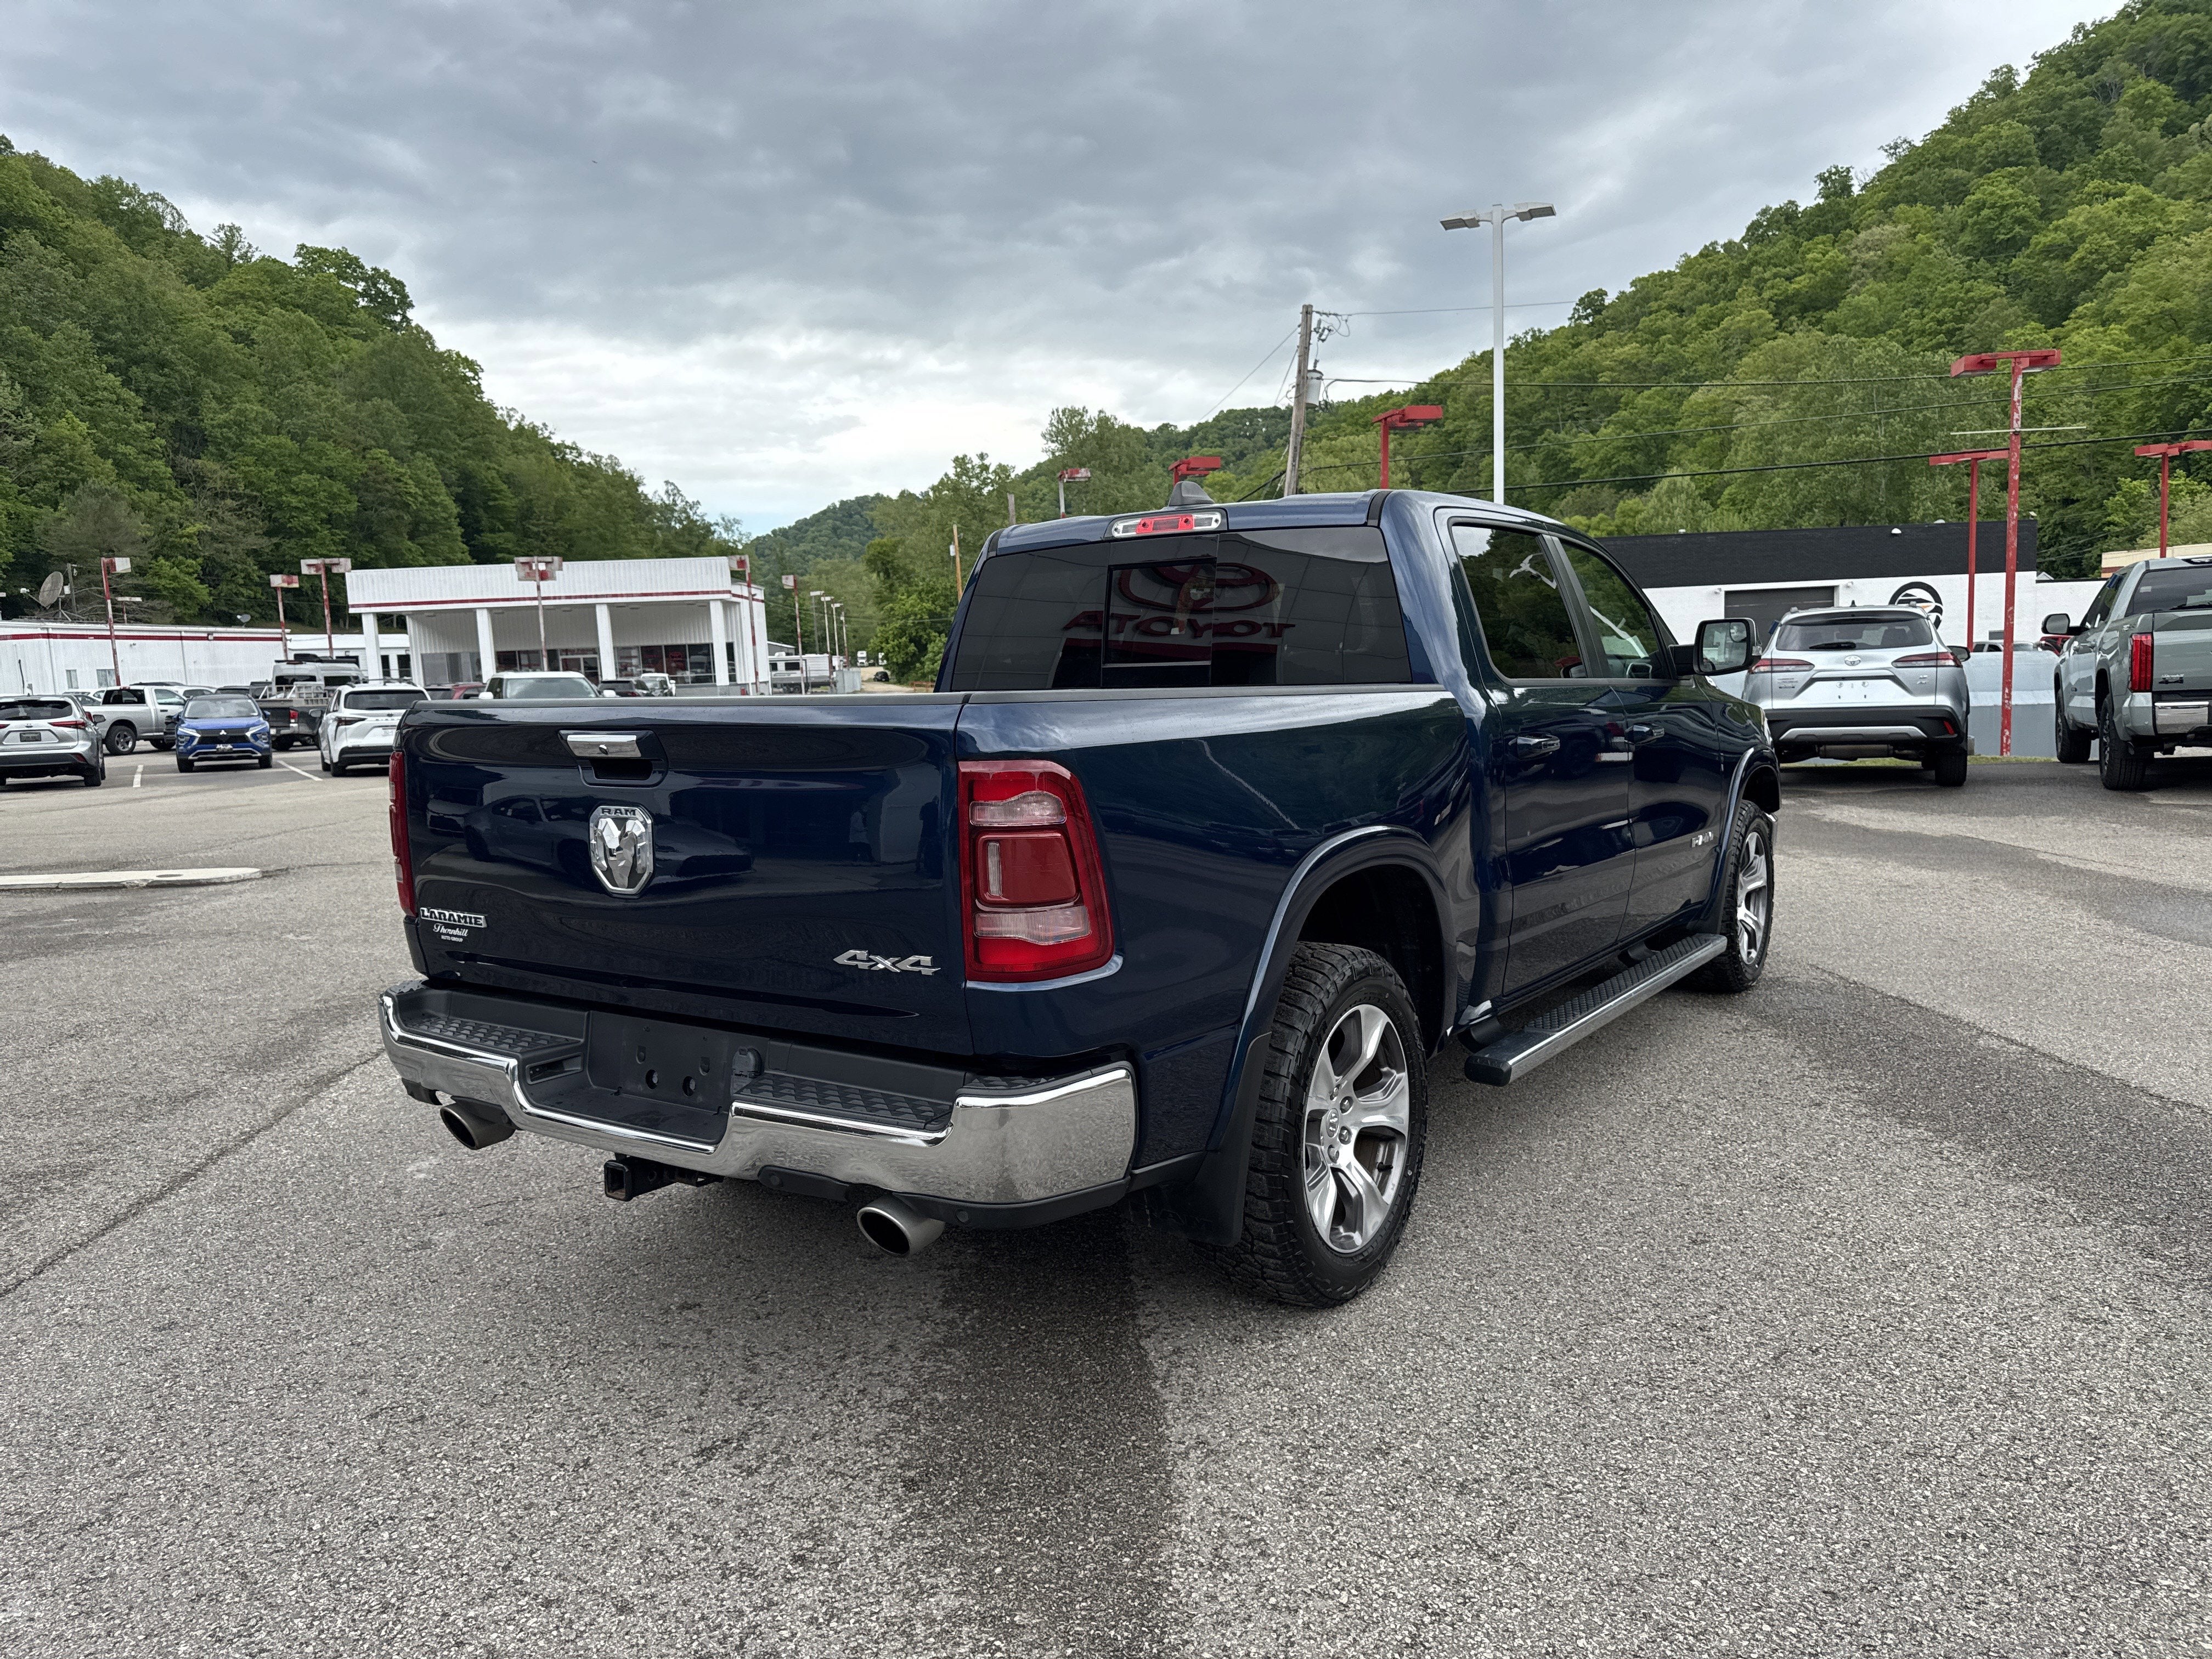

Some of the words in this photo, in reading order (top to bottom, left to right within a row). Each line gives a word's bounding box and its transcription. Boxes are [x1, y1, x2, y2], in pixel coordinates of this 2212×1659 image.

[601, 808, 636, 816] RAM
[420, 908, 484, 927] LARAMIE
[433, 923, 469, 936] Thornhill
